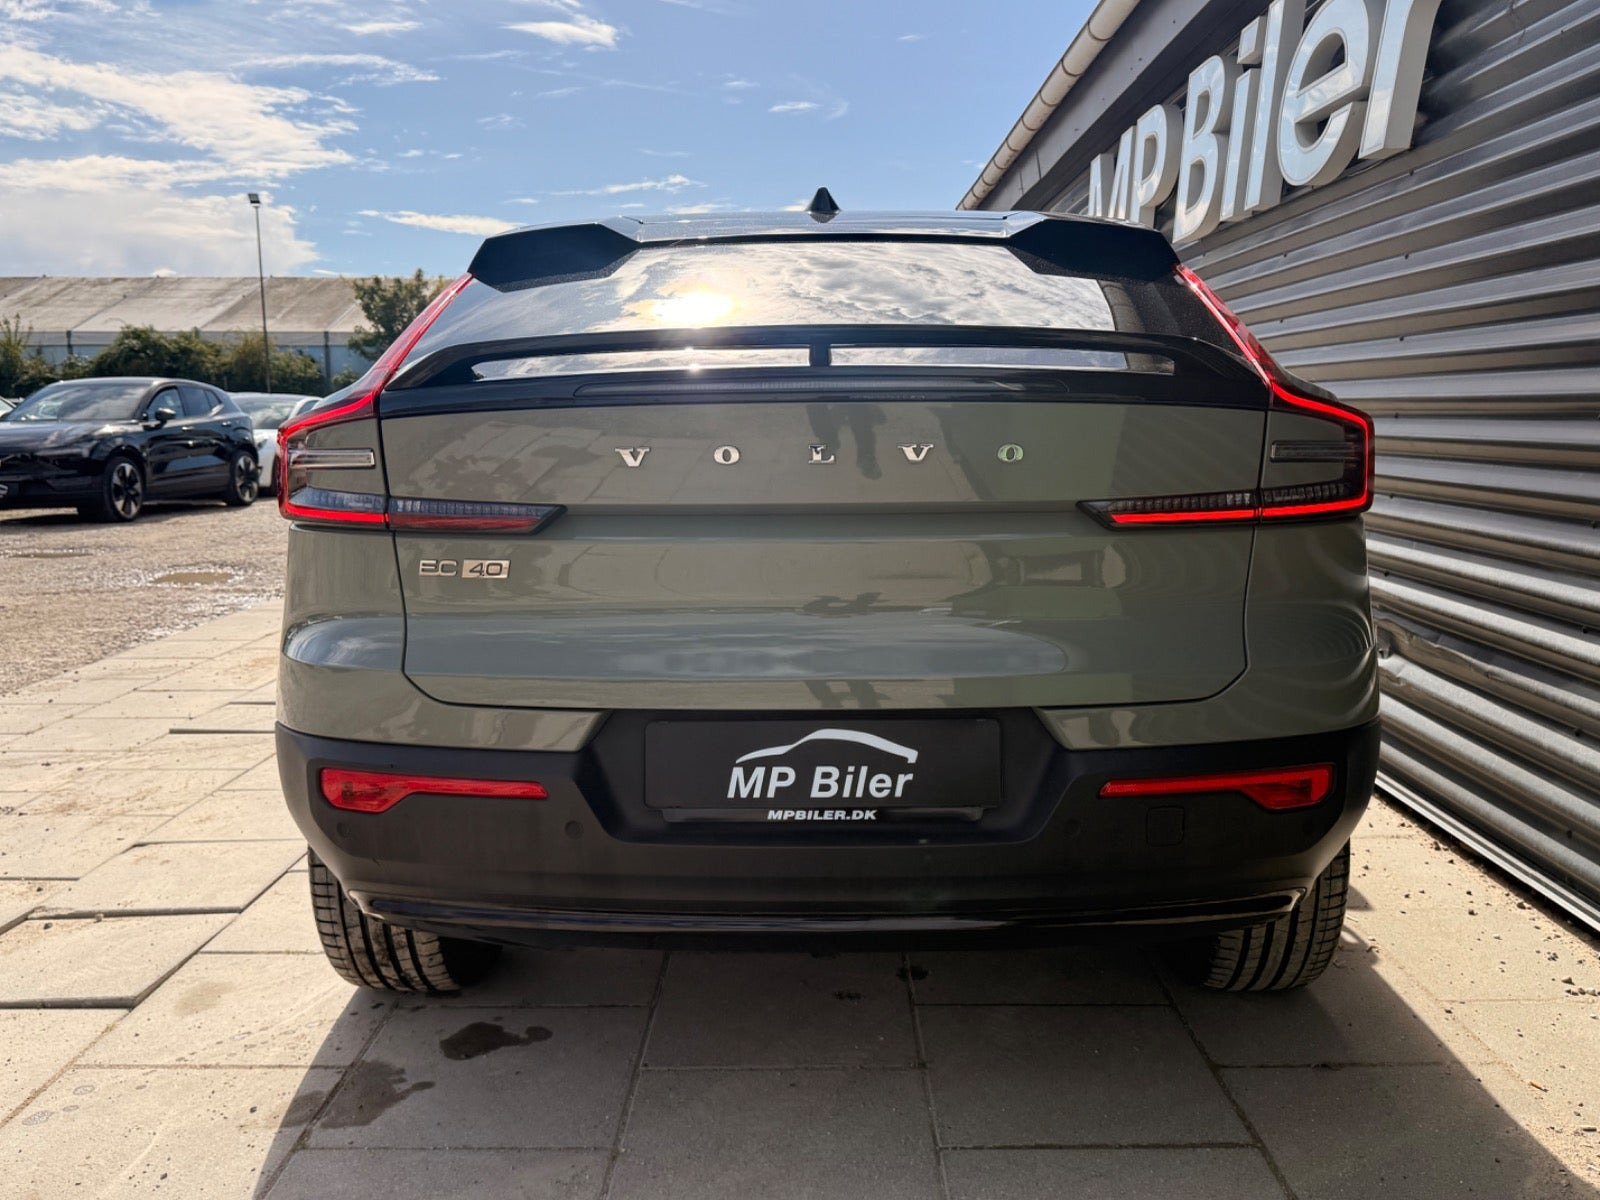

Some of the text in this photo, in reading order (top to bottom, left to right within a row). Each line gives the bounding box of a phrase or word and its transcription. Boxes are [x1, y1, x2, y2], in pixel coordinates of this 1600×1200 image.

[1088, 0, 1432, 244] MP Biler
[614, 443, 1026, 468] VOLVO
[419, 559, 458, 577] EC
[726, 765, 914, 799] MP Biler
[767, 809, 877, 821] MPBILER.DK
